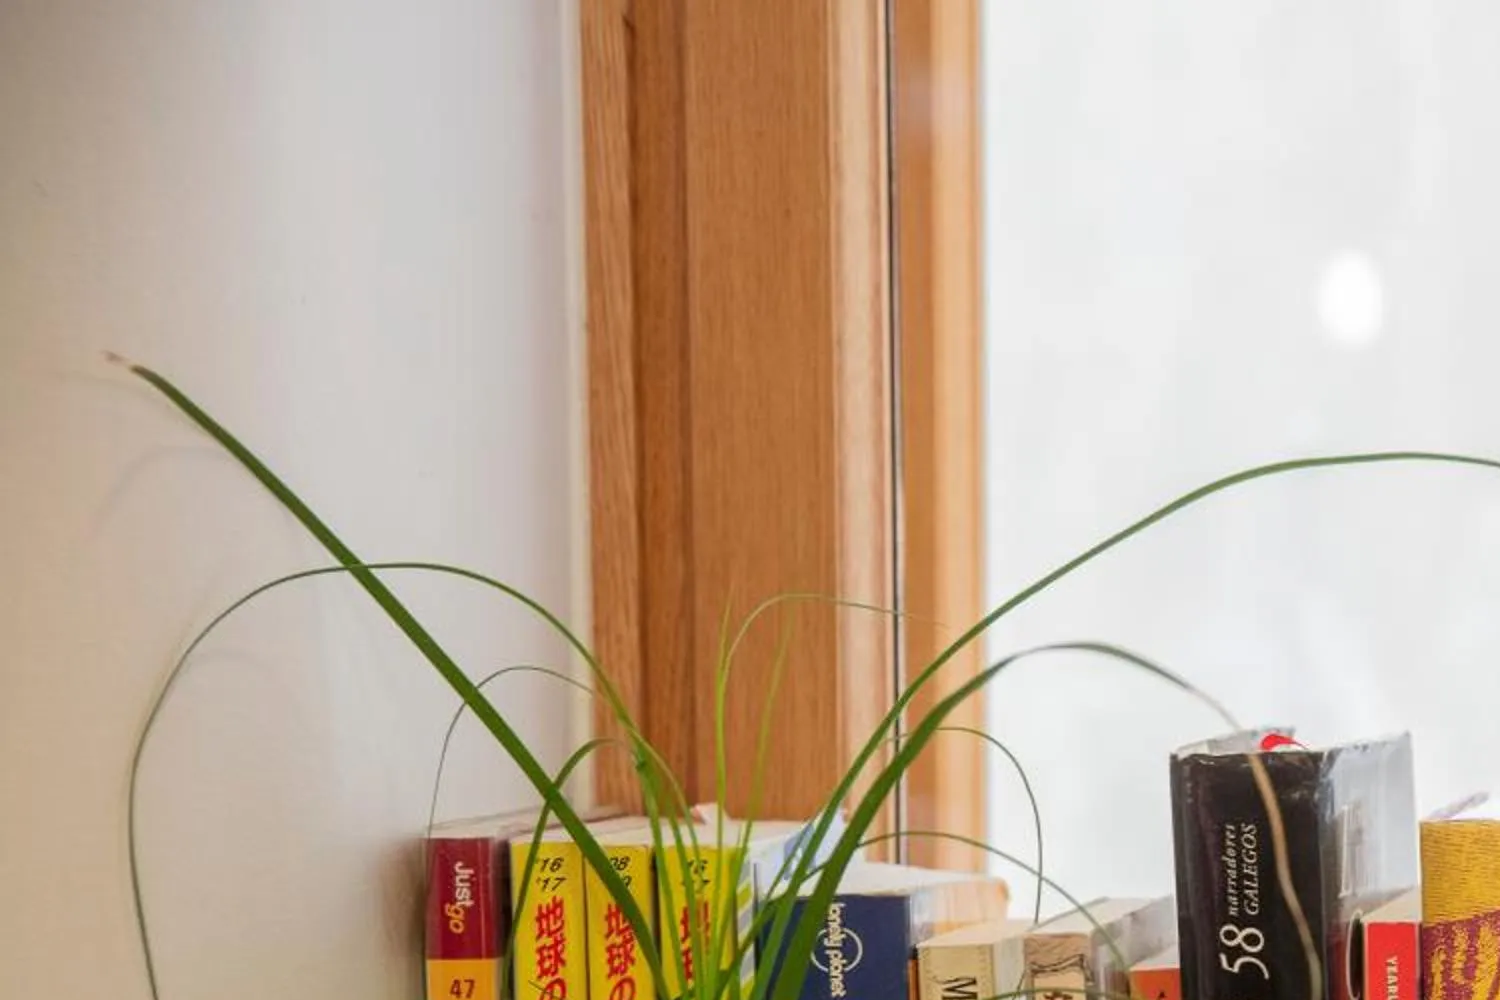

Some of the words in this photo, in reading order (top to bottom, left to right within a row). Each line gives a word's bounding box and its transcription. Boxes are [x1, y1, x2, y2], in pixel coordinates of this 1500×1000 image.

[454, 862, 474, 907] Just
[1222, 824, 1239, 917] narradores
[1241, 823, 1260, 916] GALEGOS
[445, 903, 465, 934] go
[824, 902, 847, 947] lonely
[825, 949, 848, 998] planet
[1219, 923, 1270, 980] 58
[450, 979, 476, 999] 47
